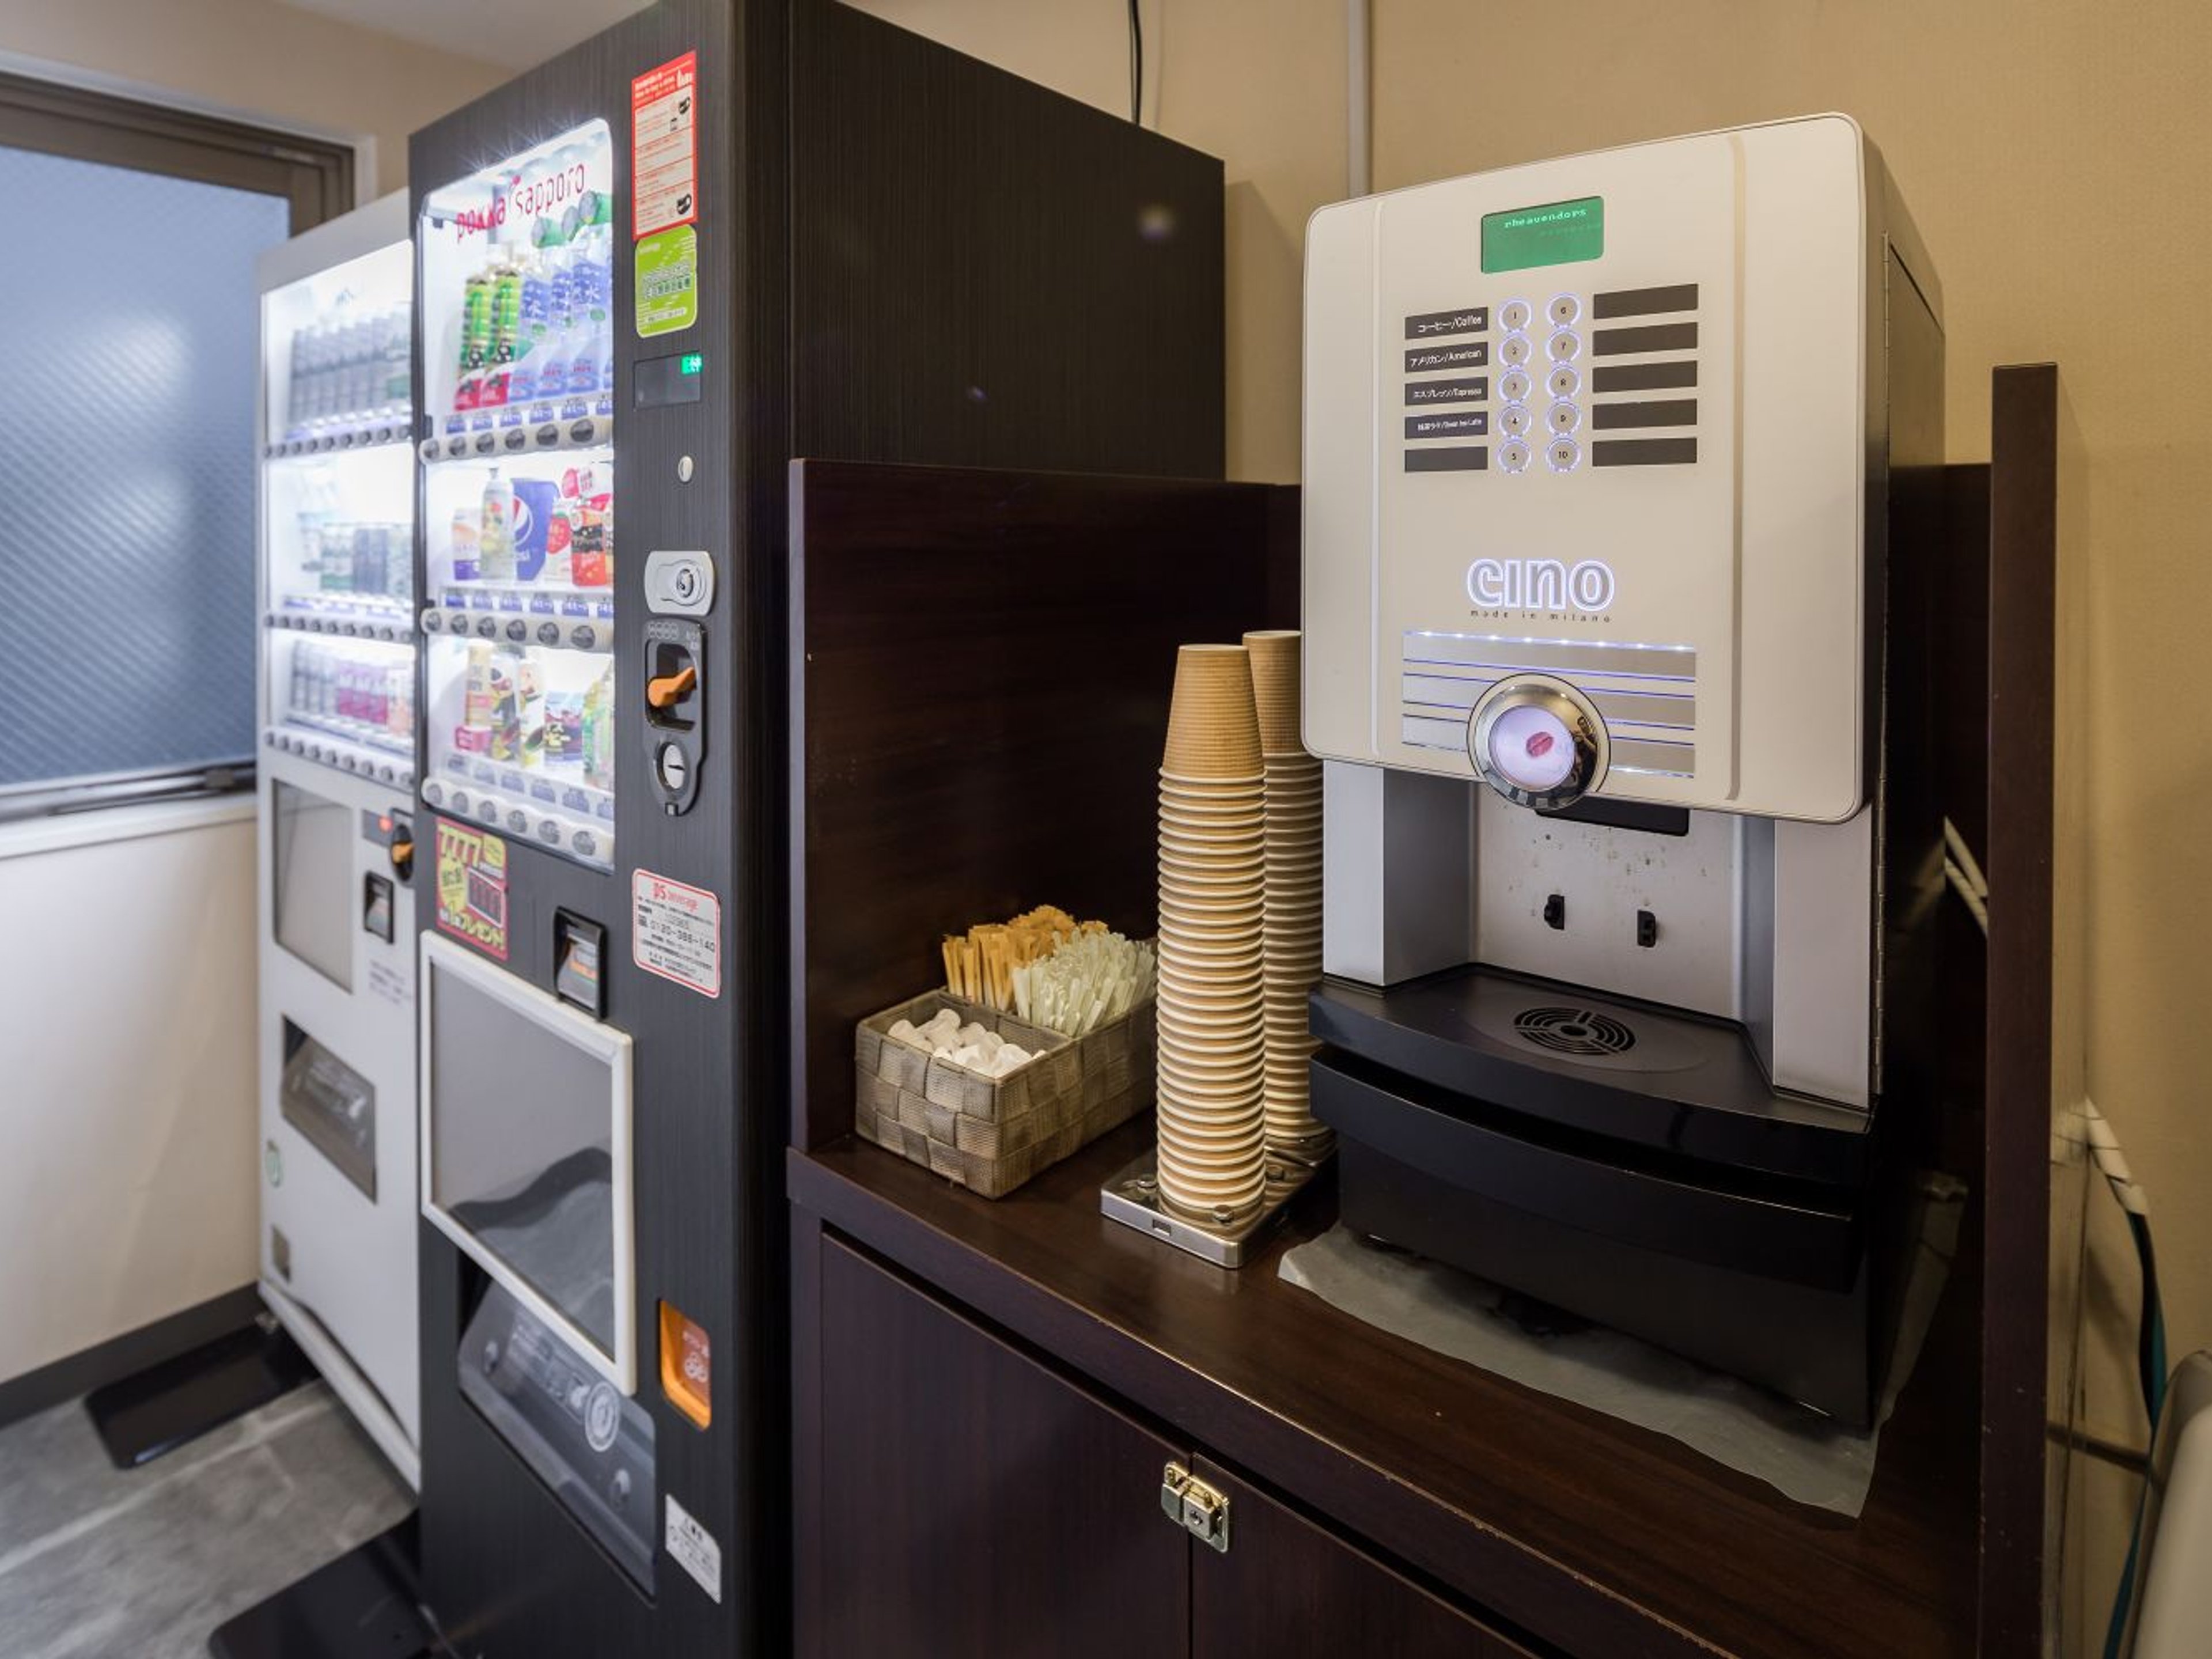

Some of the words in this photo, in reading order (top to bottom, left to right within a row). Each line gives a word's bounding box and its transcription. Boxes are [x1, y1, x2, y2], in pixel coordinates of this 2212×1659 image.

[1505, 209, 1588, 229] rheavendors
[1560, 306, 1566, 314] 6
[1558, 450, 1568, 459] 10
[1467, 558, 1615, 612] cino
[1470, 610, 1509, 618] made
[1521, 610, 1536, 620] in
[1549, 612, 1611, 623] milano
